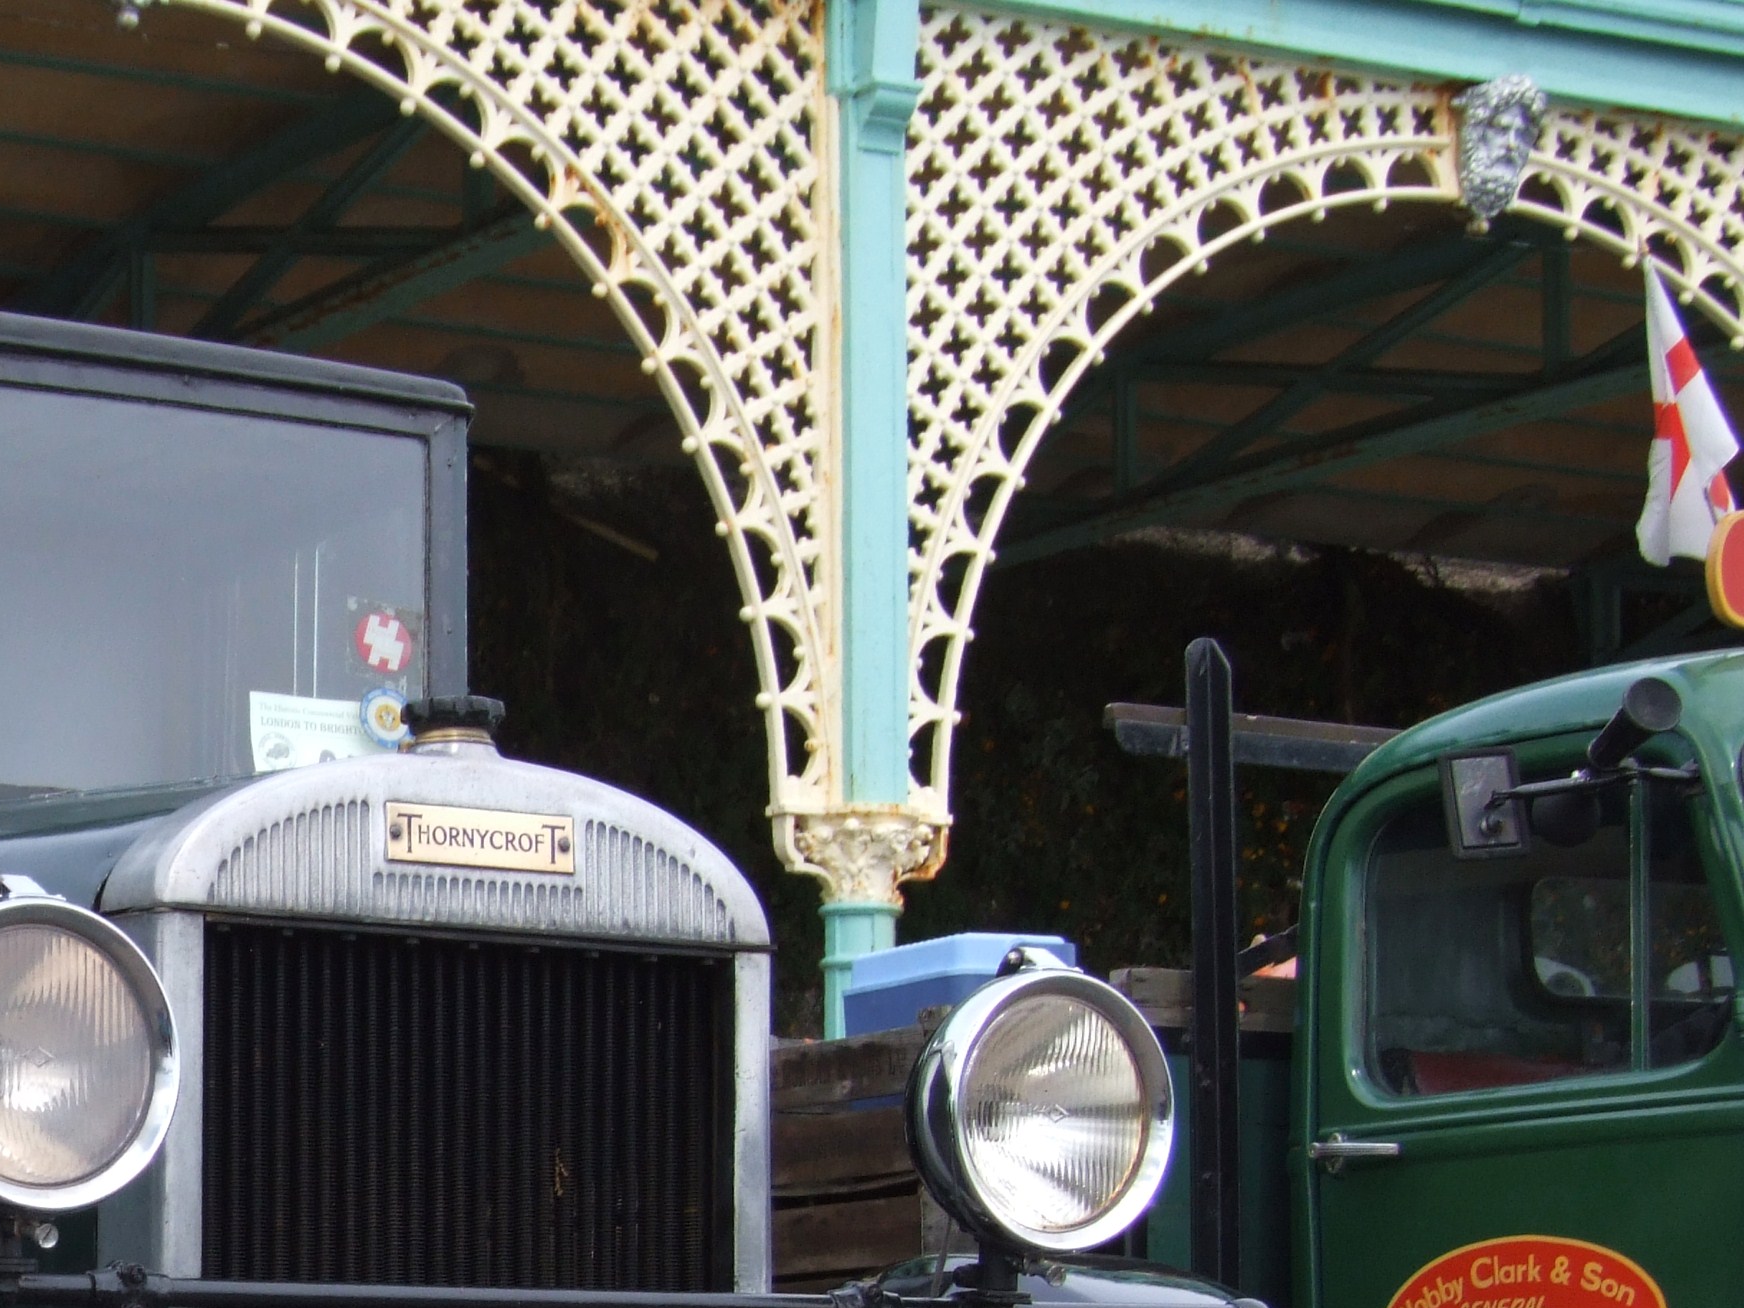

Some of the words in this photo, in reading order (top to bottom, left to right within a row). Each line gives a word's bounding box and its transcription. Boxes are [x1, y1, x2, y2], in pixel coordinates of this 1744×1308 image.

[261, 716, 300, 729] LONDON
[303, 720, 317, 731] TO
[397, 813, 566, 864] THORNYCROFT
[1470, 1254, 1541, 1290] Clark
[1549, 1256, 1569, 1286] &
[1580, 1261, 1636, 1306] Son
